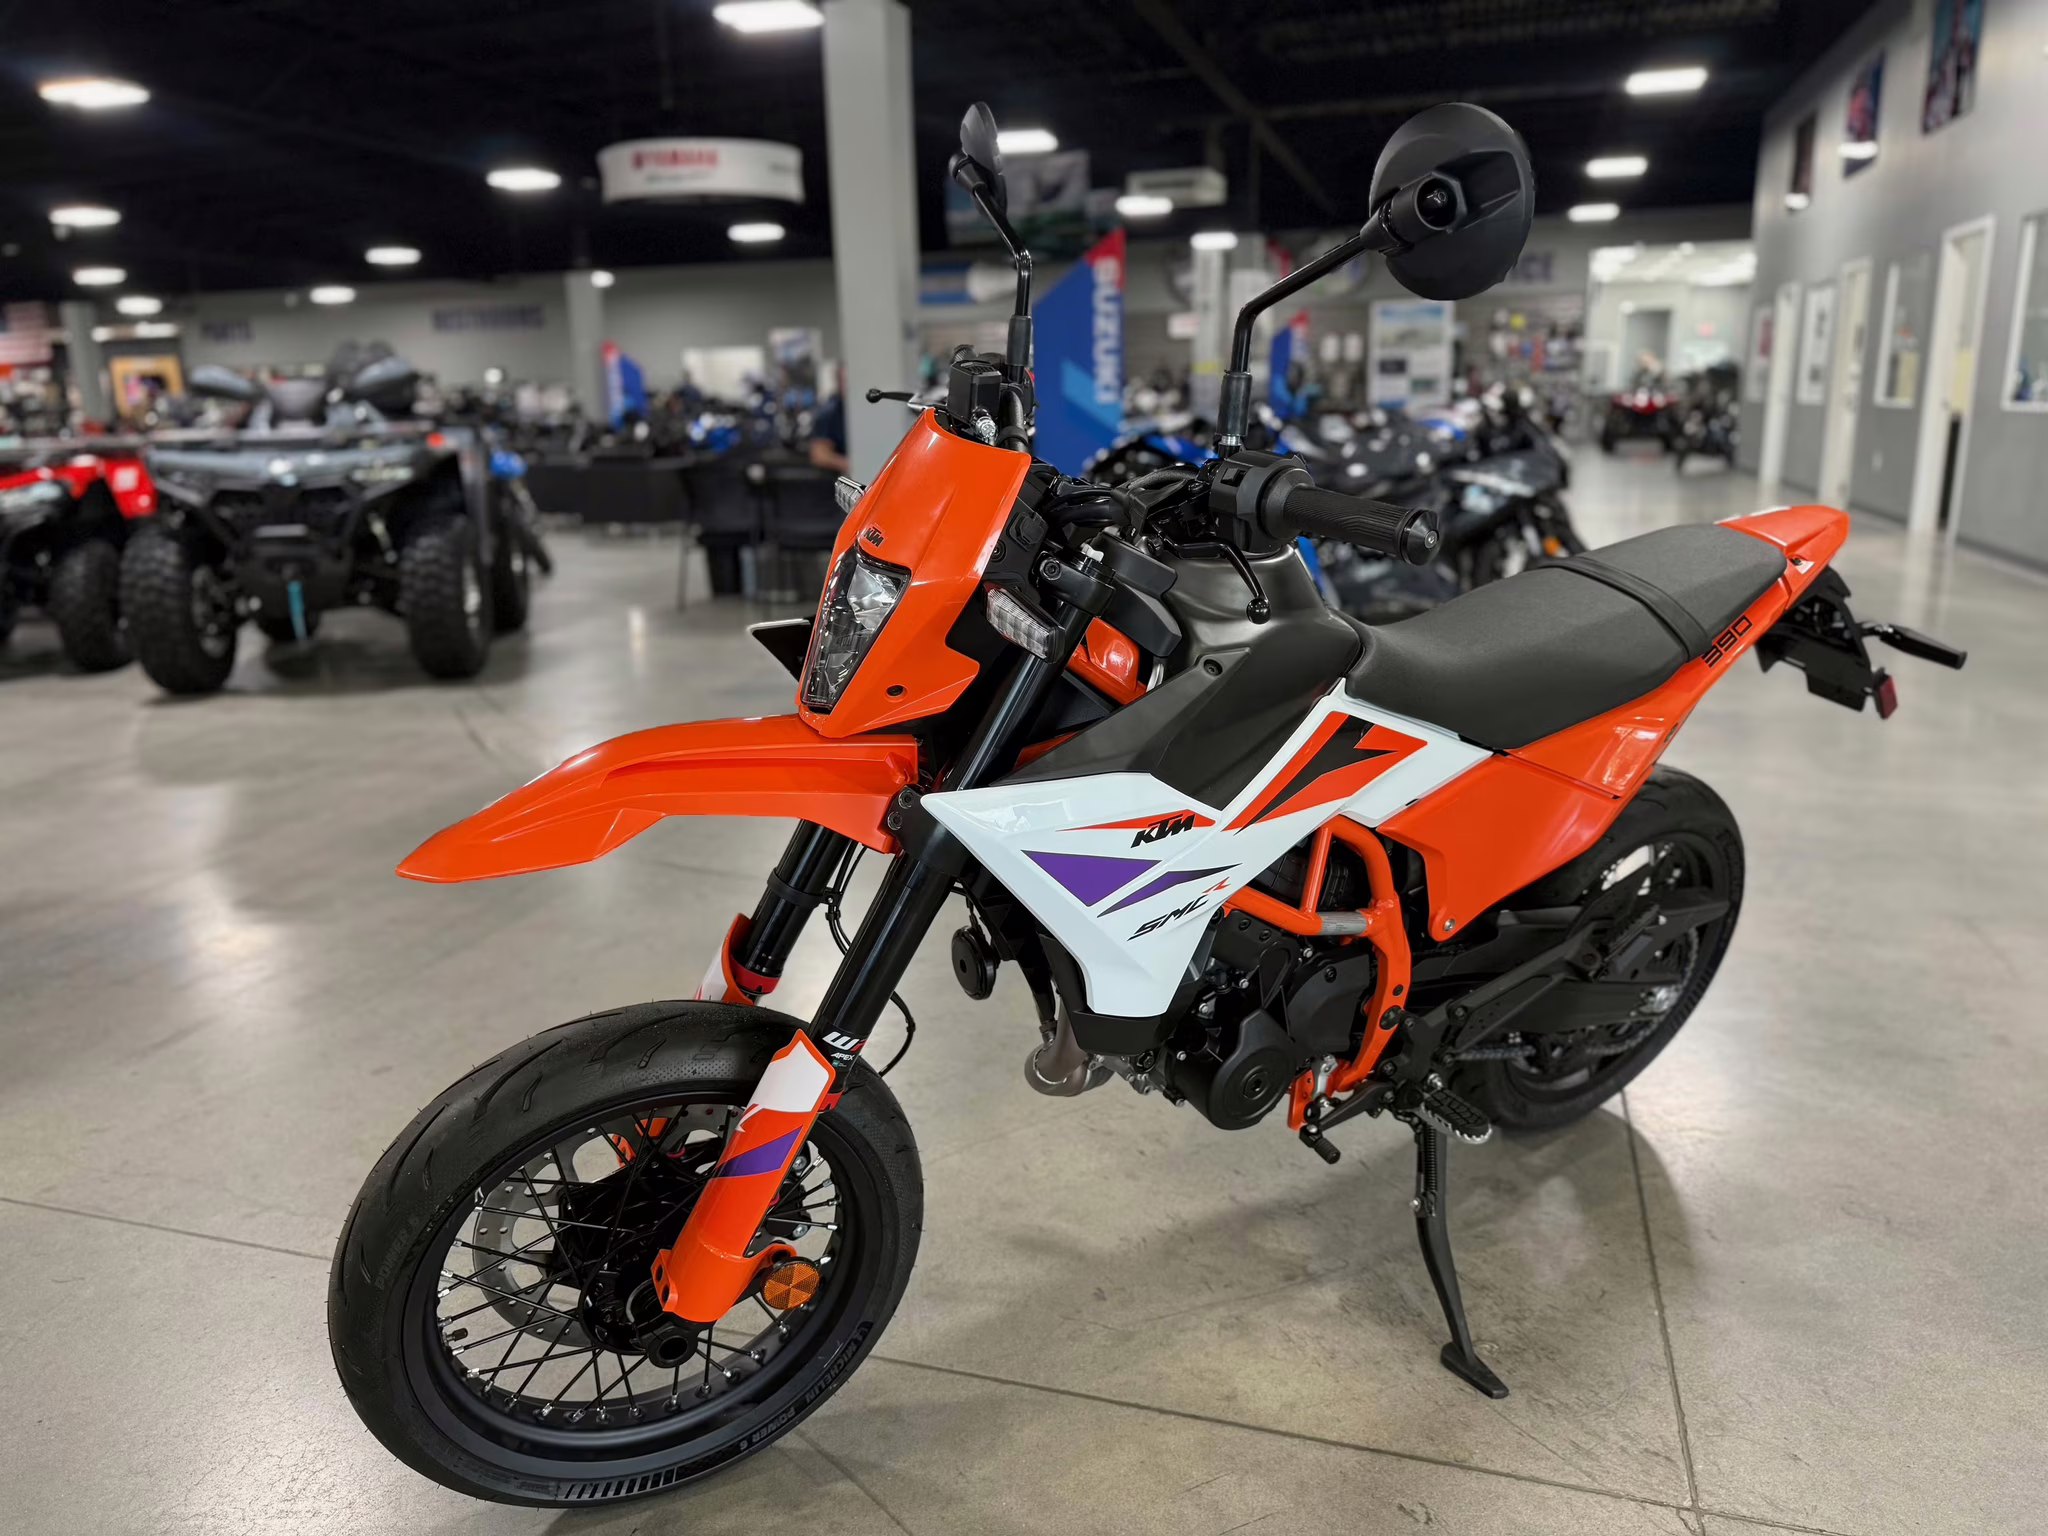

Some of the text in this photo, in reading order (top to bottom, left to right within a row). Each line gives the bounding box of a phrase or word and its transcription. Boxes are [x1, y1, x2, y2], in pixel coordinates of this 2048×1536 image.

[1093, 257, 1121, 405] SUZUKI
[863, 526, 885, 548] KTM
[1702, 615, 1753, 669] 390
[1130, 813, 1197, 849] KTM
[1126, 894, 1209, 942] SMC
[830, 1052, 856, 1061] APEX
[374, 1227, 411, 1291] POWER
[738, 1340, 857, 1451] MICHELIN POWER 6
